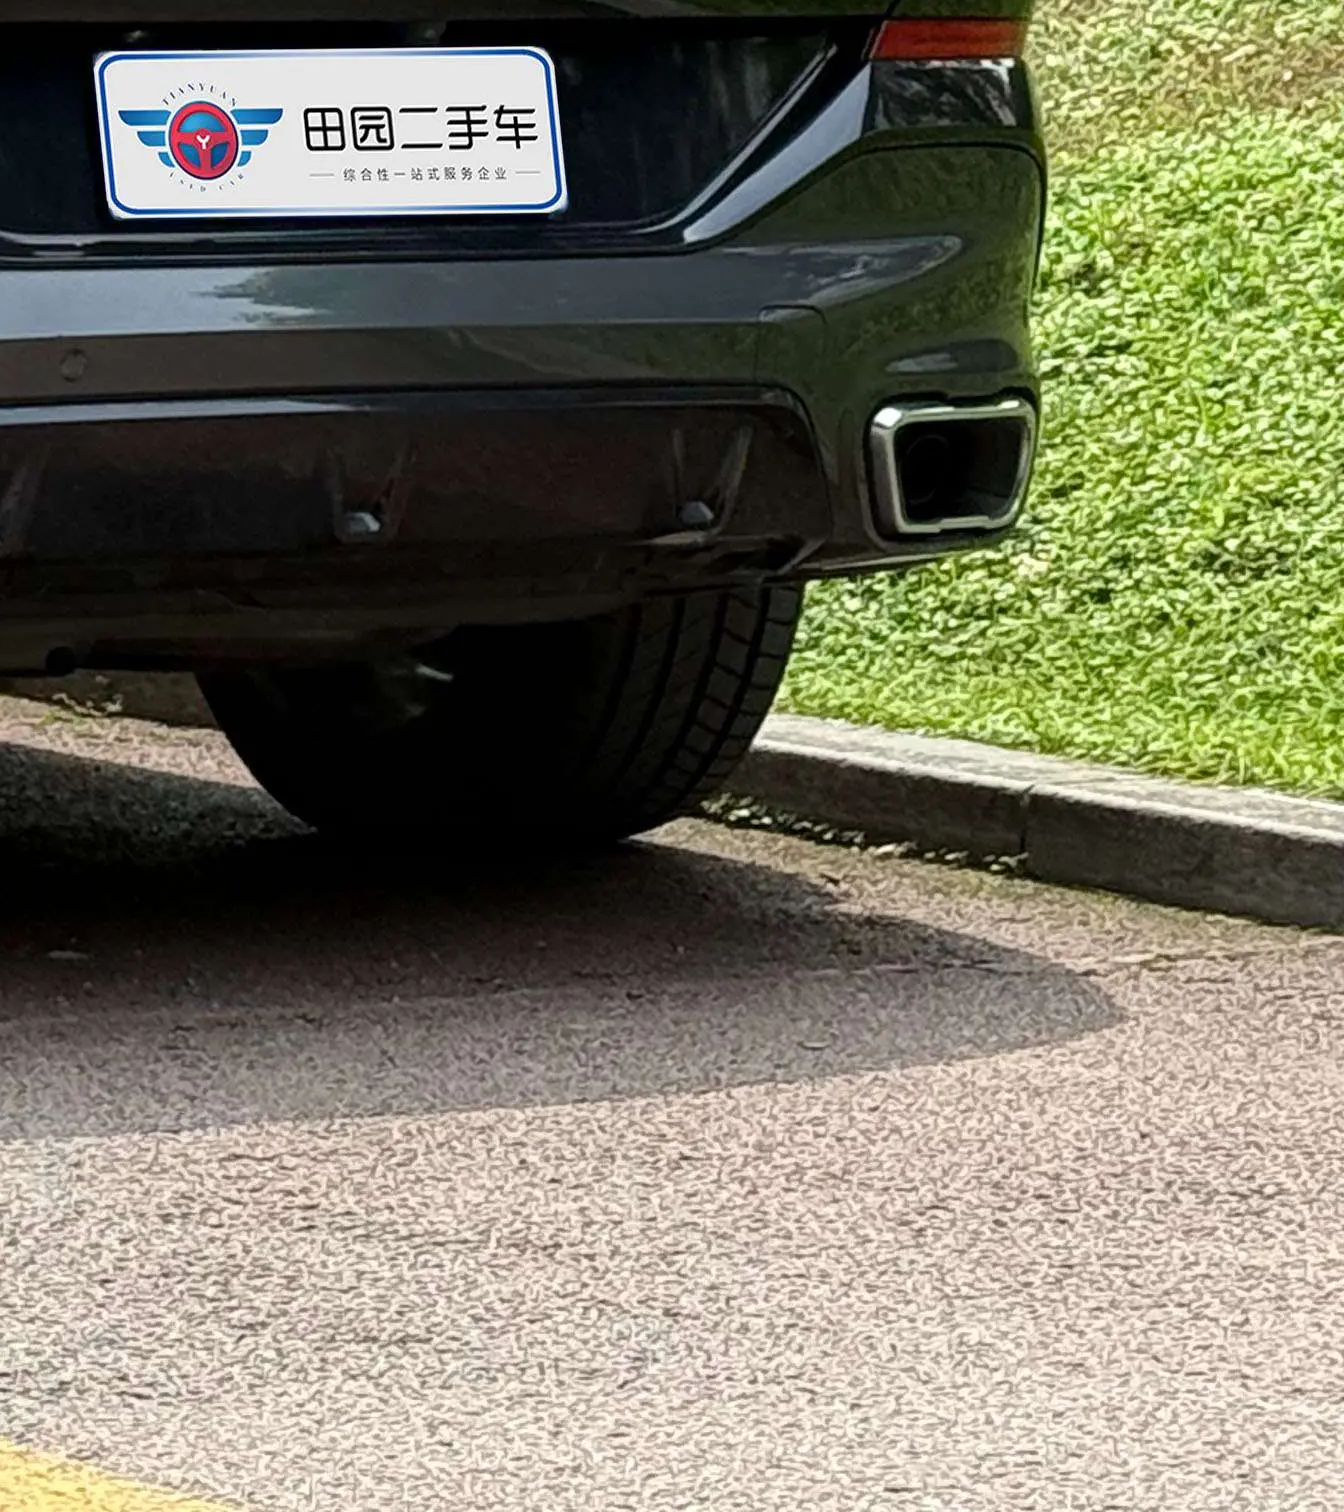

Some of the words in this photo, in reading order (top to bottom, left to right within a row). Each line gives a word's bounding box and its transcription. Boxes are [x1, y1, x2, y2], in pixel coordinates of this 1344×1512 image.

[303, 104, 539, 152] 田园二手车
[343, 165, 508, 182] 综合性一站式服务企业
